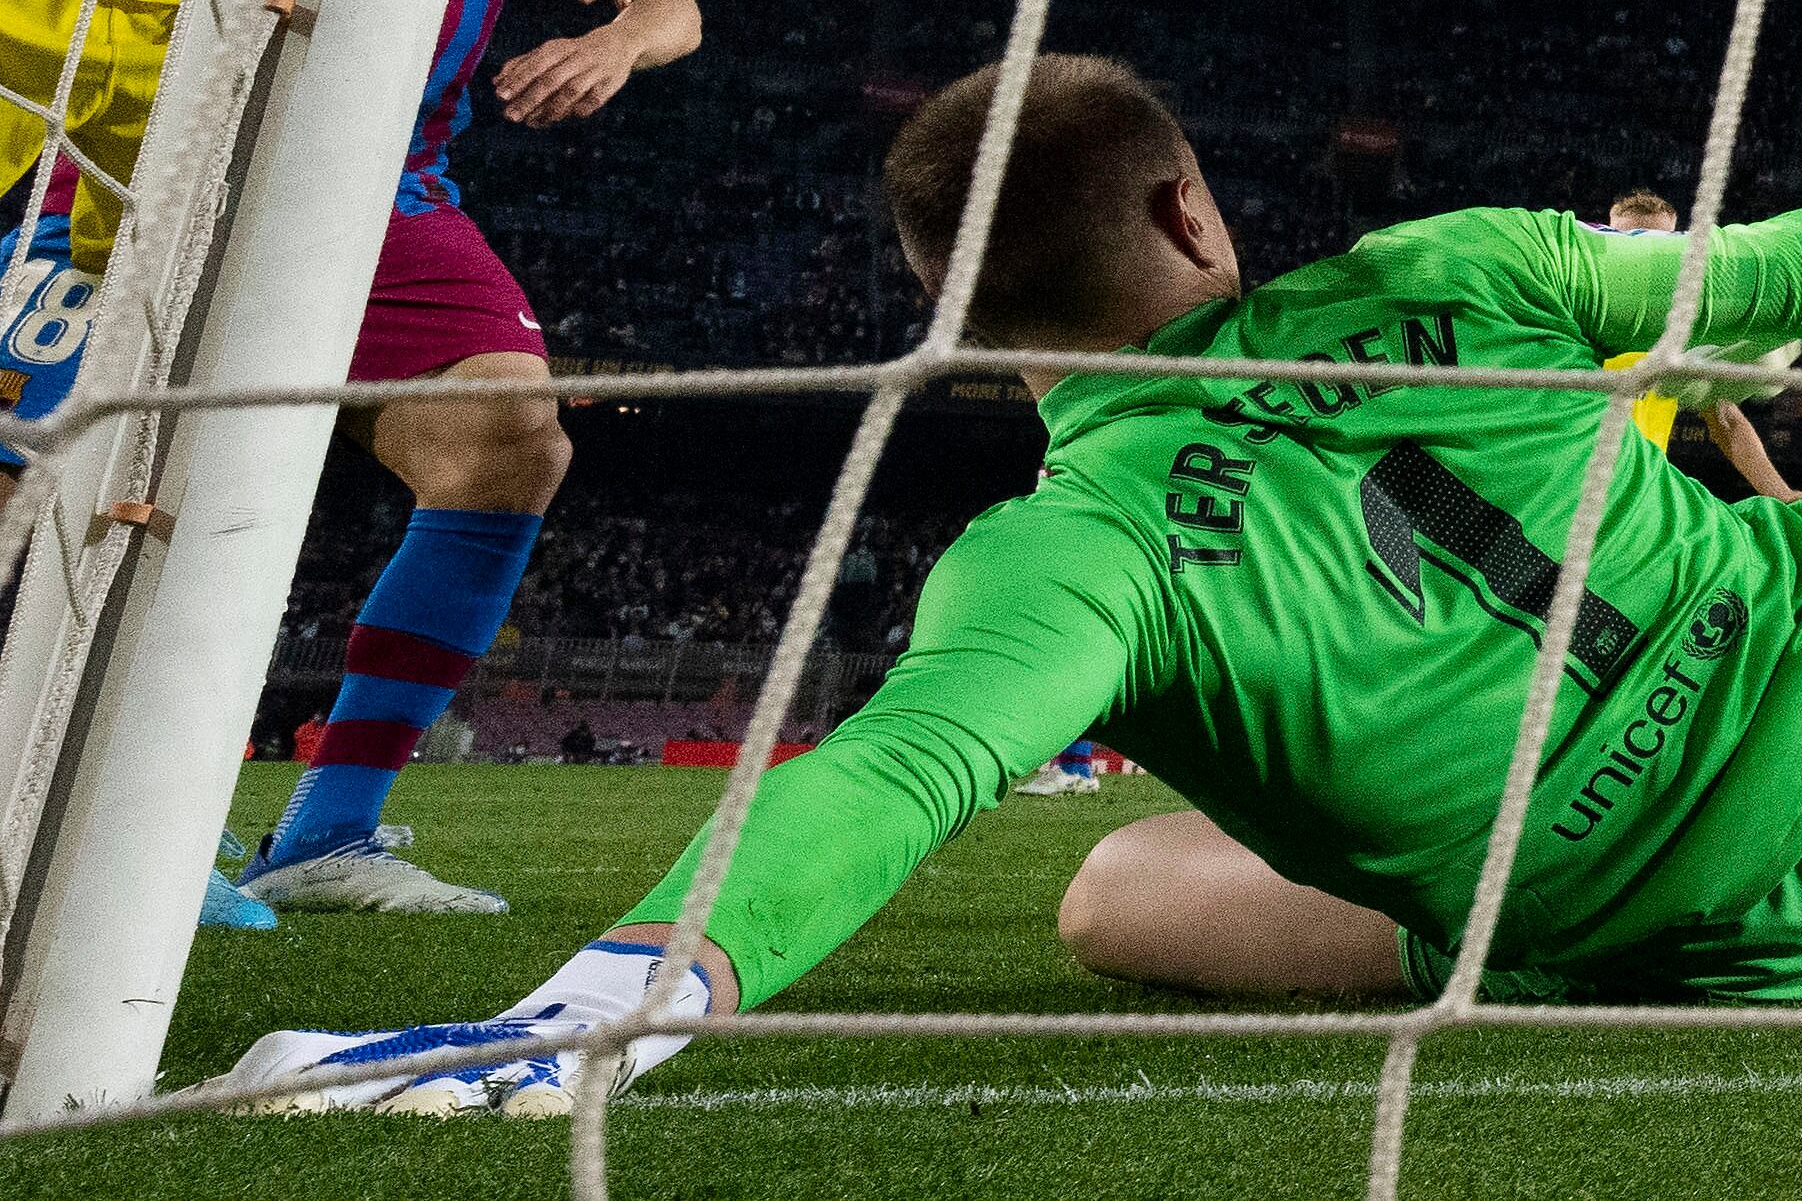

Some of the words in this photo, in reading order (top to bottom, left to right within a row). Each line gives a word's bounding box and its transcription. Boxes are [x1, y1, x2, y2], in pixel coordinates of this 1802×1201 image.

[1166, 441, 1256, 573] TER
[1360, 439, 1640, 693] 1
[1551, 651, 1701, 842] unicef
